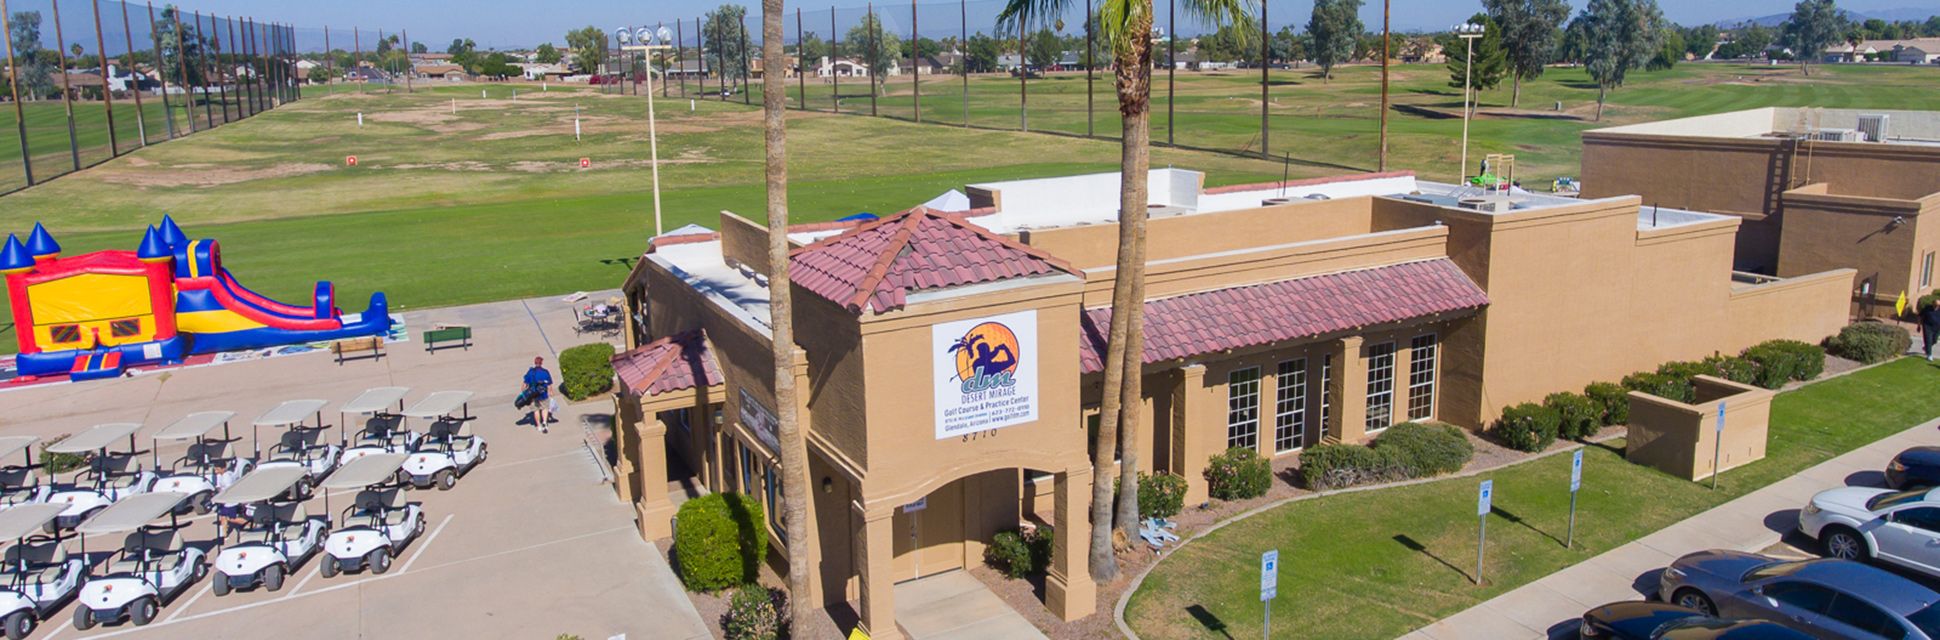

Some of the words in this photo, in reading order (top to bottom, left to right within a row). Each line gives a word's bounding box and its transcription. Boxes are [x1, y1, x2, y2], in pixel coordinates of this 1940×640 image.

[961, 391, 987, 404] DESERT
[989, 386, 1016, 398] MIRAGE
[944, 408, 958, 417] Golf
[958, 405, 979, 415] Course
[985, 399, 1009, 409] Practice
[1010, 396, 1029, 405] Center
[962, 428, 997, 443] 8710
